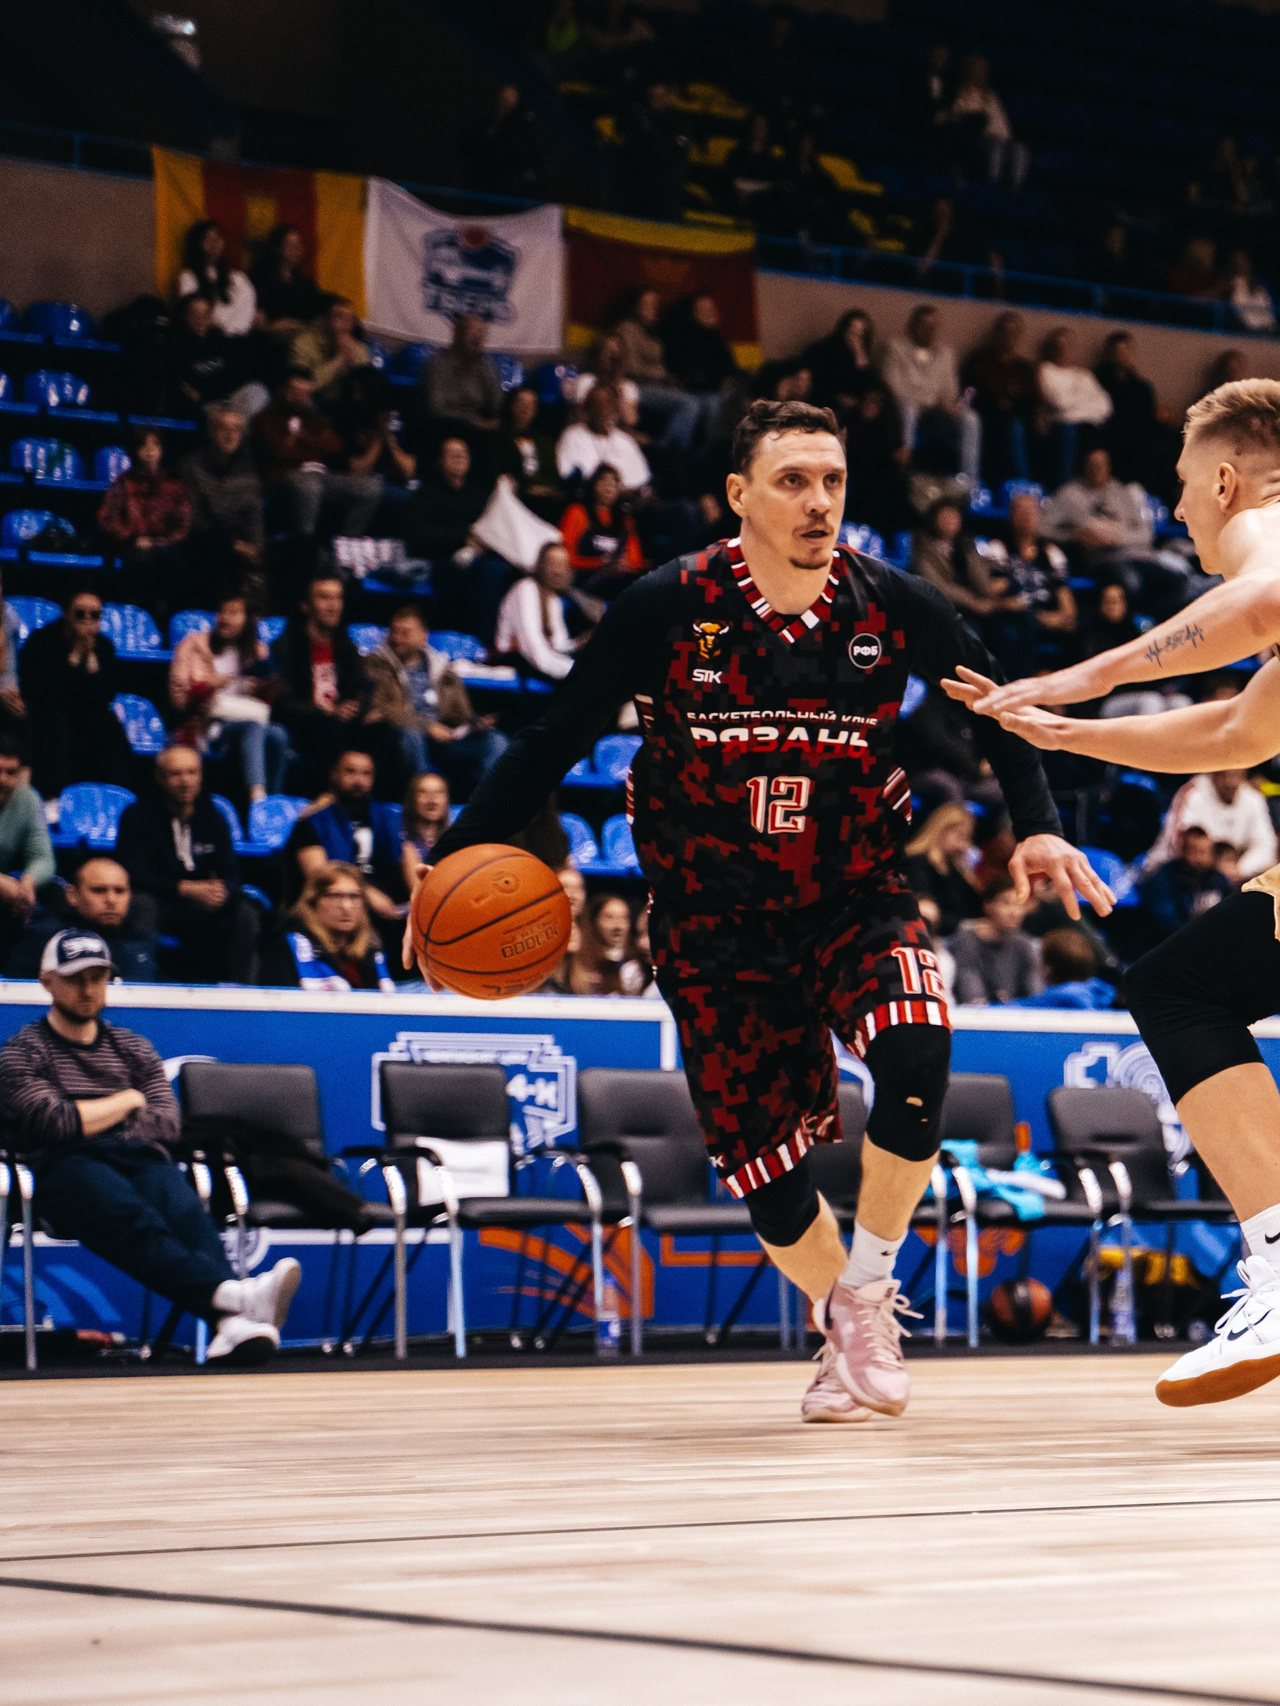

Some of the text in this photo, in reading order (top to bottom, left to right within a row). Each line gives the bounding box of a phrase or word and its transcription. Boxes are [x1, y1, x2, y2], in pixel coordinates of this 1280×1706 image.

[691, 668, 722, 684] STK
[690, 726, 869, 759] РЯЗАНЬ
[746, 775, 811, 835] 12
[890, 946, 946, 1000] 12
